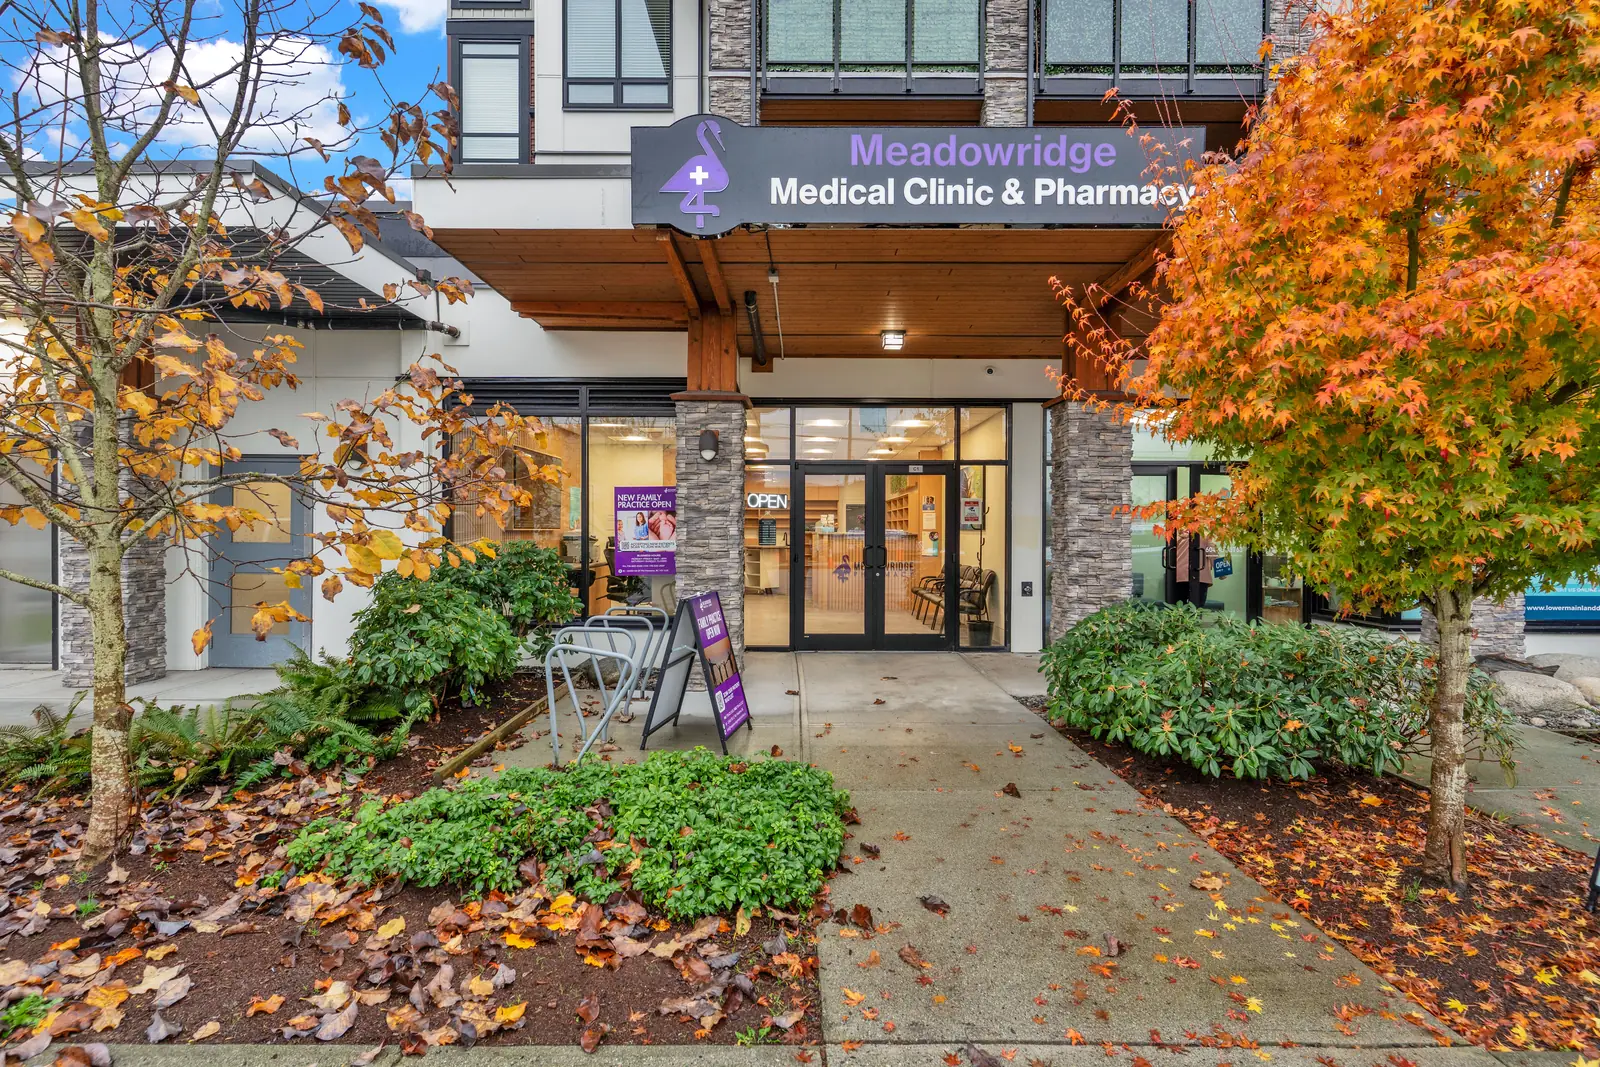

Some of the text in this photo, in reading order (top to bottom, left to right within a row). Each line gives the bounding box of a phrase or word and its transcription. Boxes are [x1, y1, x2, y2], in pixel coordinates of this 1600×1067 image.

[851, 134, 1117, 173] Meadowridge
[770, 177, 1195, 212] Medical Clinic & Pharmacy
[617, 501, 650, 509] PRACTICE
[747, 493, 787, 509] OPEN
[854, 562, 914, 570] MERIDGE
